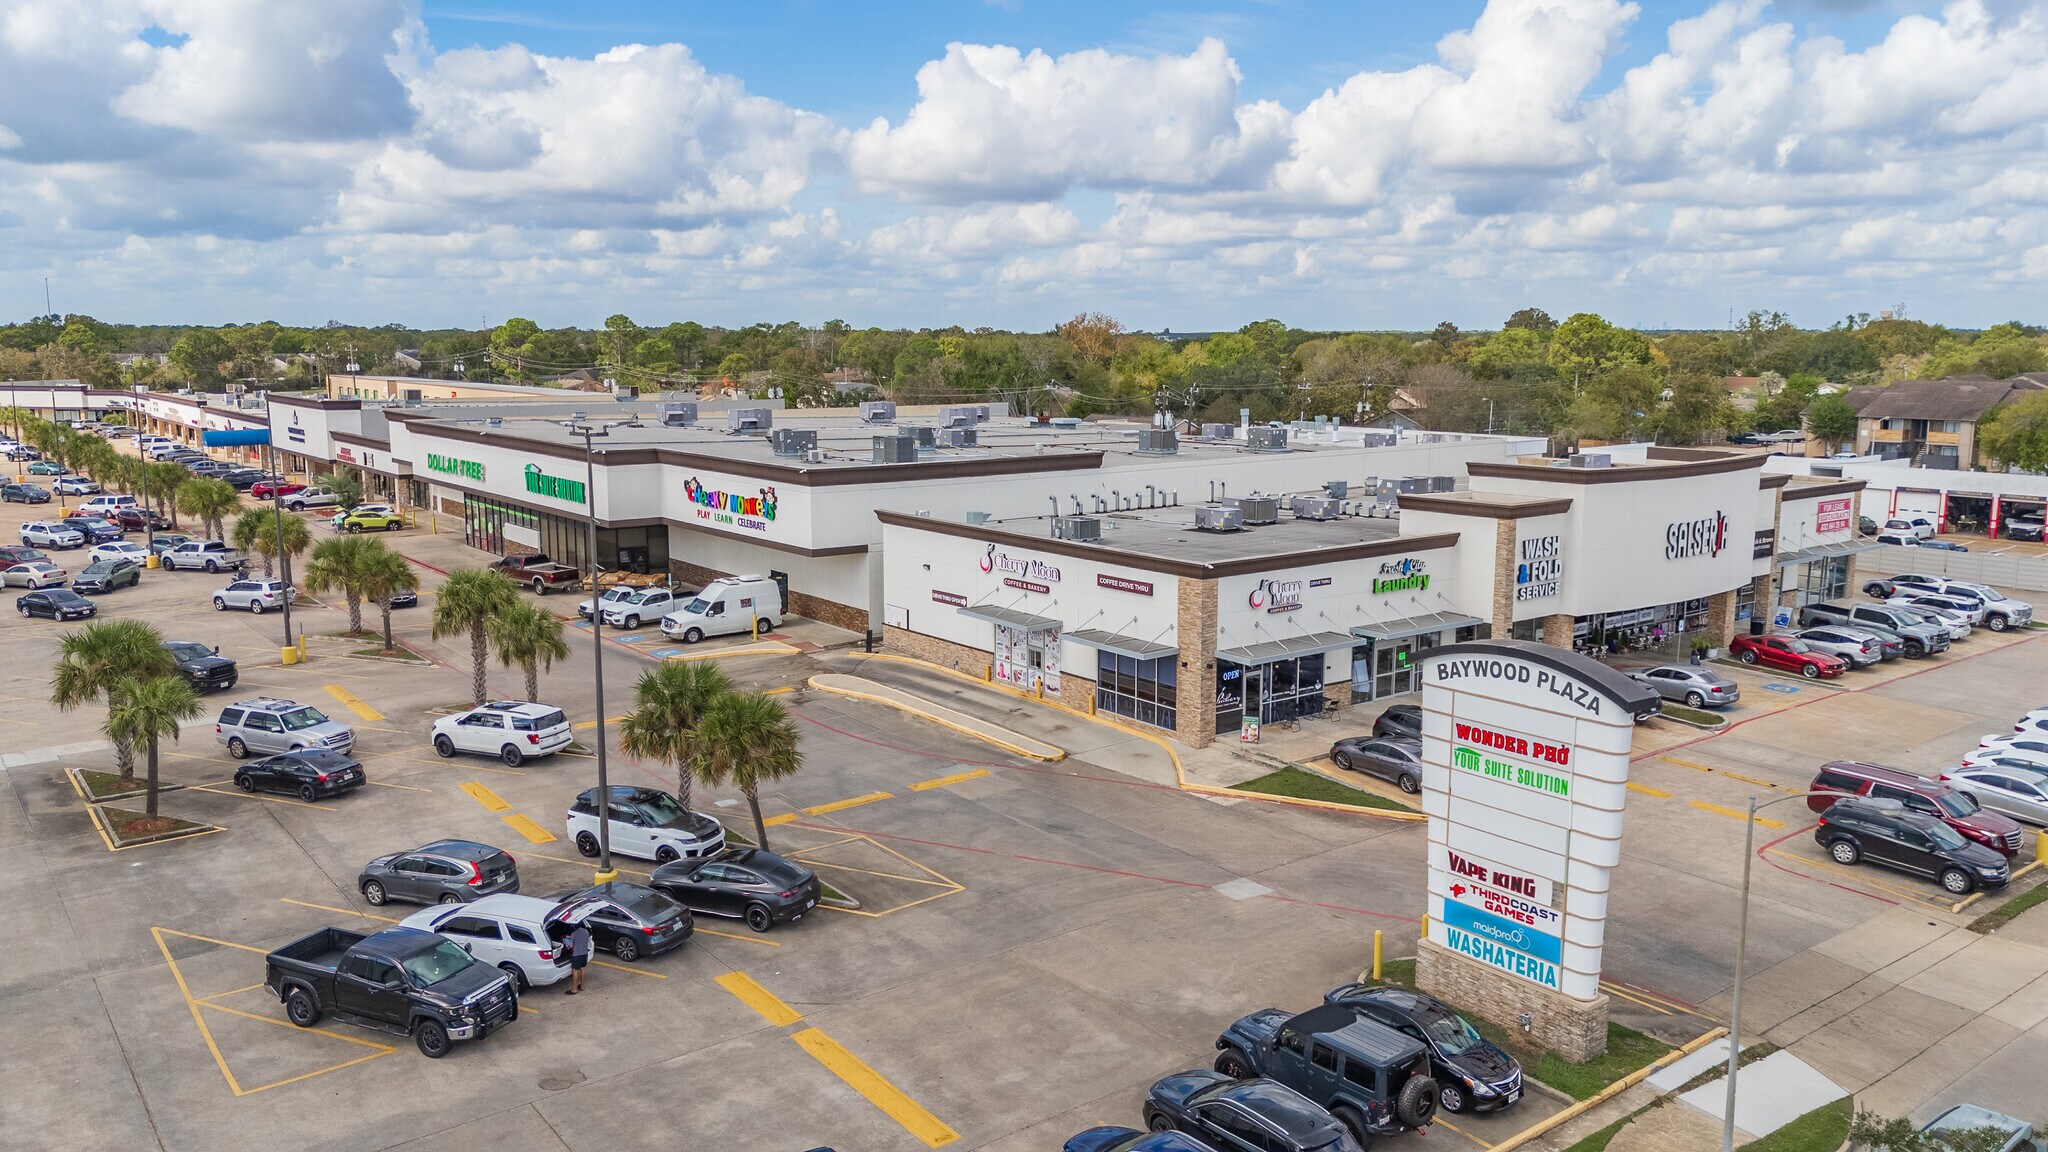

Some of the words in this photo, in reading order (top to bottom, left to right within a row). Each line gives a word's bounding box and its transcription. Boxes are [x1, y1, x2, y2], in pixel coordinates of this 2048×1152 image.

[427, 453, 459, 475] DOLLAR
[460, 459, 482, 481] TREE
[556, 477, 586, 504] SOLUTION
[1823, 503, 1832, 512] FOR
[1832, 502, 1846, 511] LEASE
[697, 509, 710, 520] PLAY
[714, 513, 733, 525] LEARN
[738, 517, 767, 532] CELEBRATE
[1666, 511, 1729, 560] SALSERIA
[1523, 536, 1561, 560] WASH
[994, 552, 1029, 577] Cherry
[1031, 559, 1061, 581] Moon
[1517, 563, 1529, 584] &
[1531, 559, 1562, 582] FOLD
[1004, 578, 1022, 588] COFFEE
[1028, 583, 1047, 592] BAKERY
[1099, 577, 1118, 586] COFFEE
[1119, 581, 1134, 590] DRIVE
[1135, 583, 1149, 593] THRU
[1269, 580, 1302, 594] Cherry
[1373, 572, 1430, 594] Laundry
[1518, 582, 1560, 601] SERVICE
[1272, 593, 1300, 606] Moon
[1223, 669, 1240, 681] OPEN
[1437, 660, 1530, 684] BAYWOOD
[1536, 670, 1600, 716] PLAZA
[1455, 723, 1528, 756] WONDER
[1454, 751, 1480, 772] YOUR
[1484, 759, 1513, 781] SUITE
[1517, 767, 1568, 796] SOLUTION
[1447, 850, 1488, 882] VAPE
[1492, 871, 1536, 899] KING
[1484, 900, 1535, 926] GAMES
[1472, 921, 1511, 940] maidpro
[1447, 927, 1557, 988] WASHATERIA
